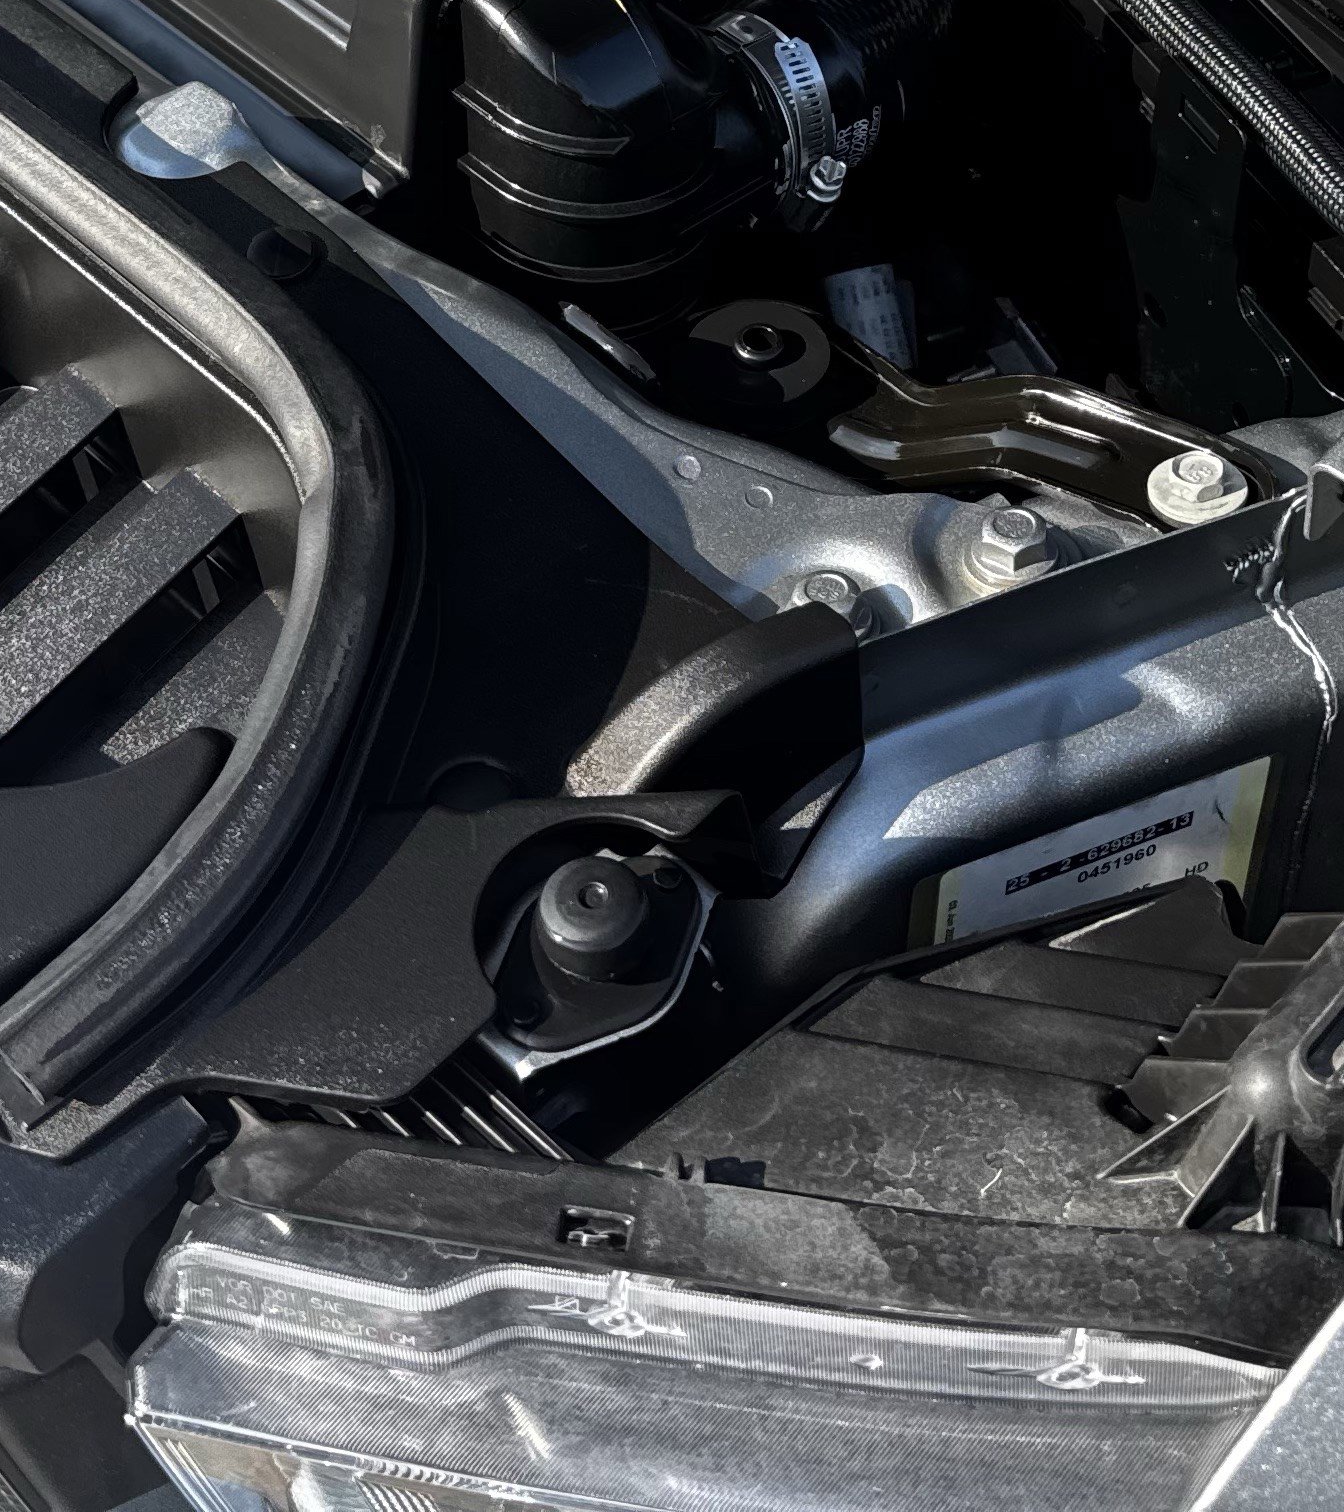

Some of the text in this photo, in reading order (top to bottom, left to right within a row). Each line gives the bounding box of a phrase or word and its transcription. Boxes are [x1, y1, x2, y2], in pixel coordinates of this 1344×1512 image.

[1077, 844, 1157, 883] 0451960
[1184, 861, 1209, 877] HD
[1007, 872, 1031, 892] 25
[263, 1286, 297, 1304] DOT
[310, 1297, 346, 1316] SAE
